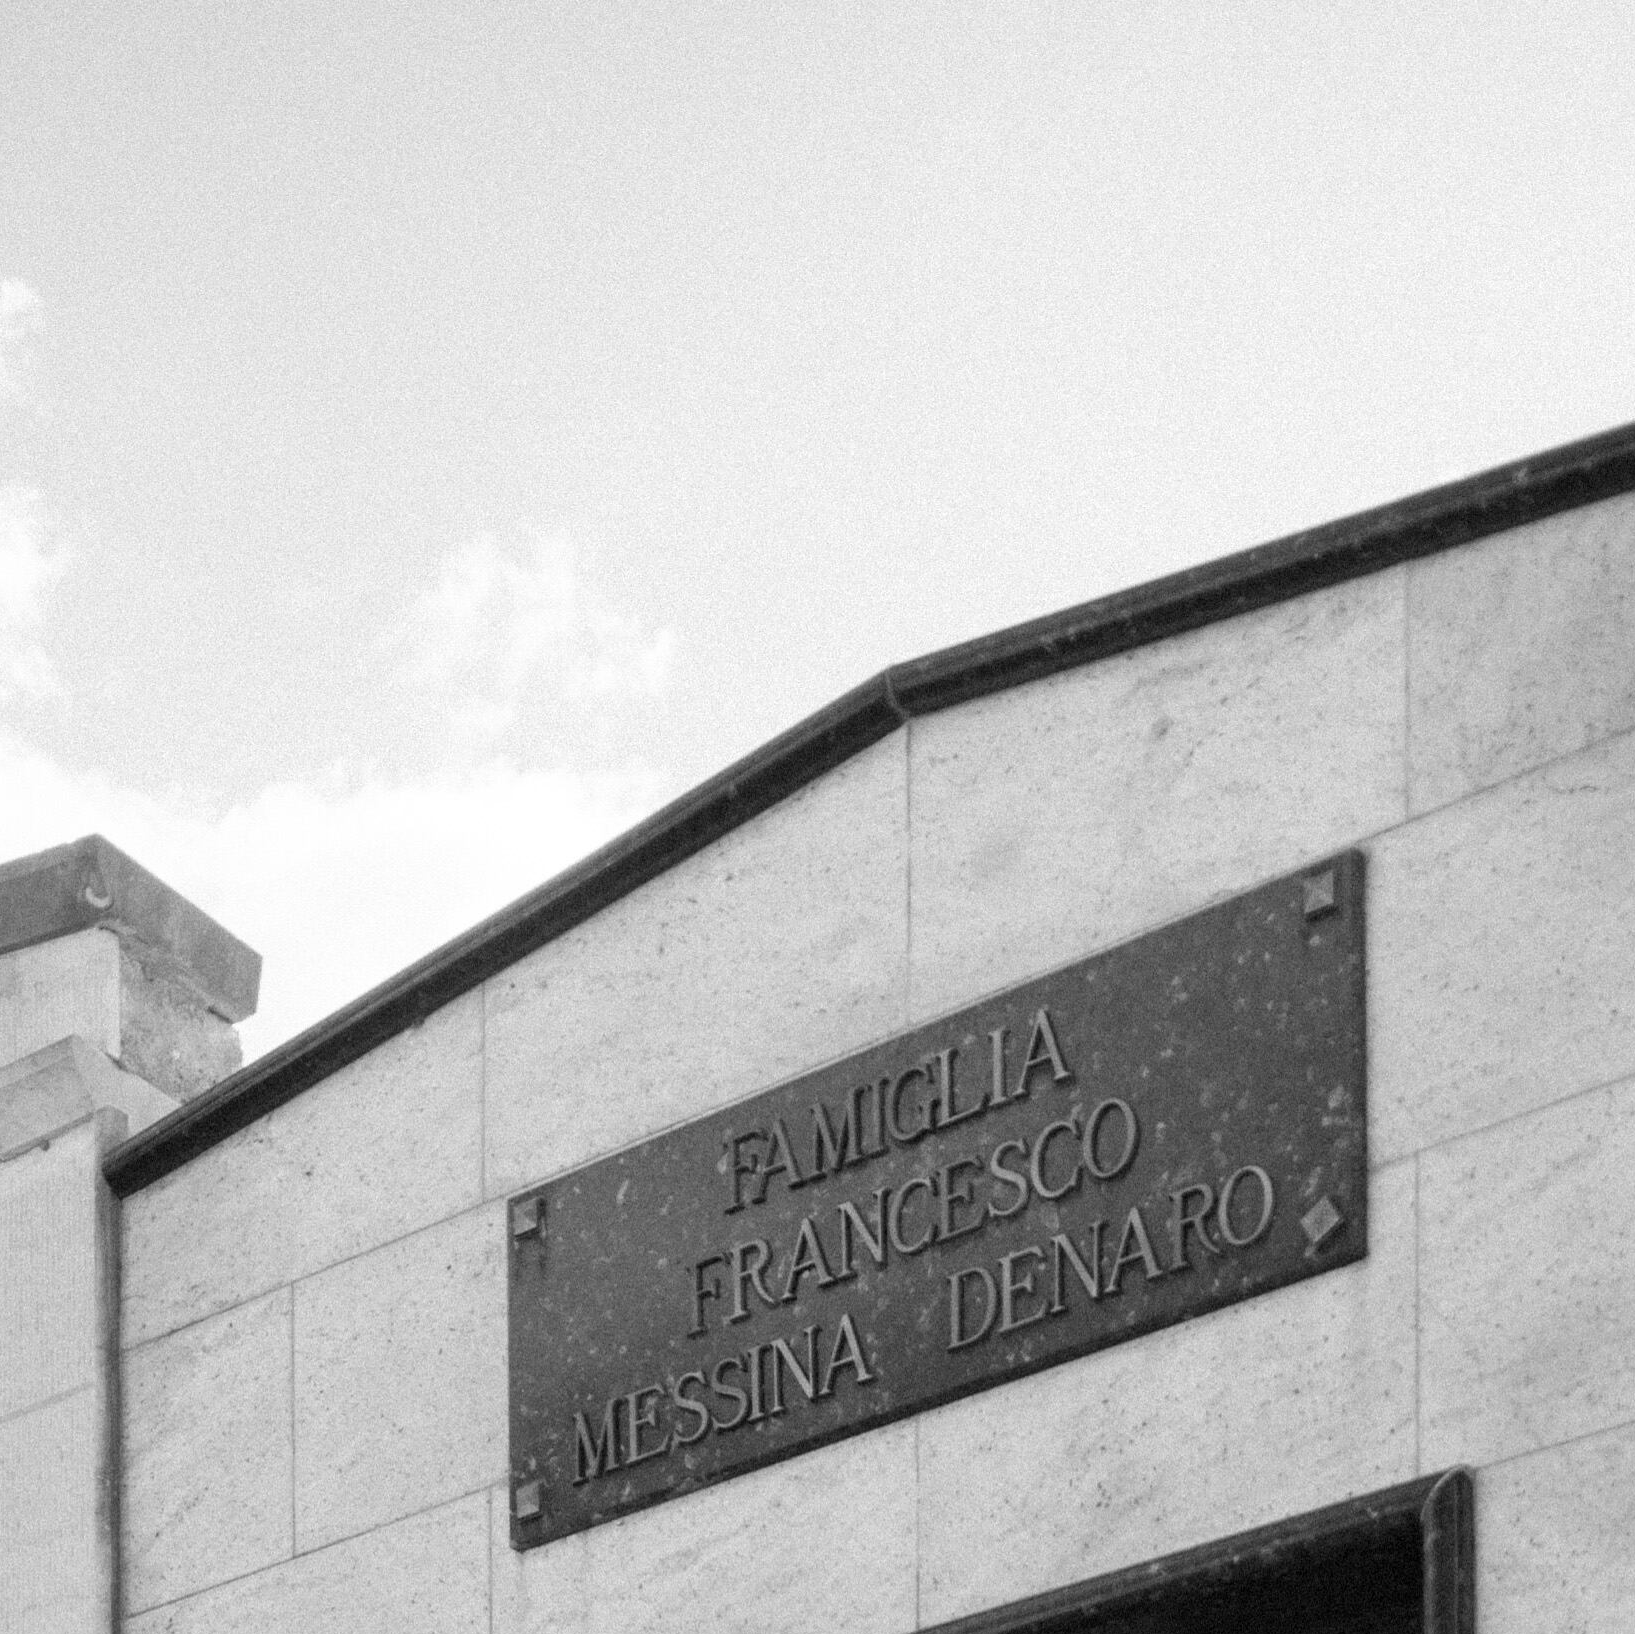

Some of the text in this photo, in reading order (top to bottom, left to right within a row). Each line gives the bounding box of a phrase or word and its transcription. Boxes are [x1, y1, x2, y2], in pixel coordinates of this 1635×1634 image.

[689, 1098, 1142, 1336] FRANCESCO
[724, 1008, 1072, 1214] FAMIGLIA
[572, 1164, 1277, 1485] MESSINA DENARO
